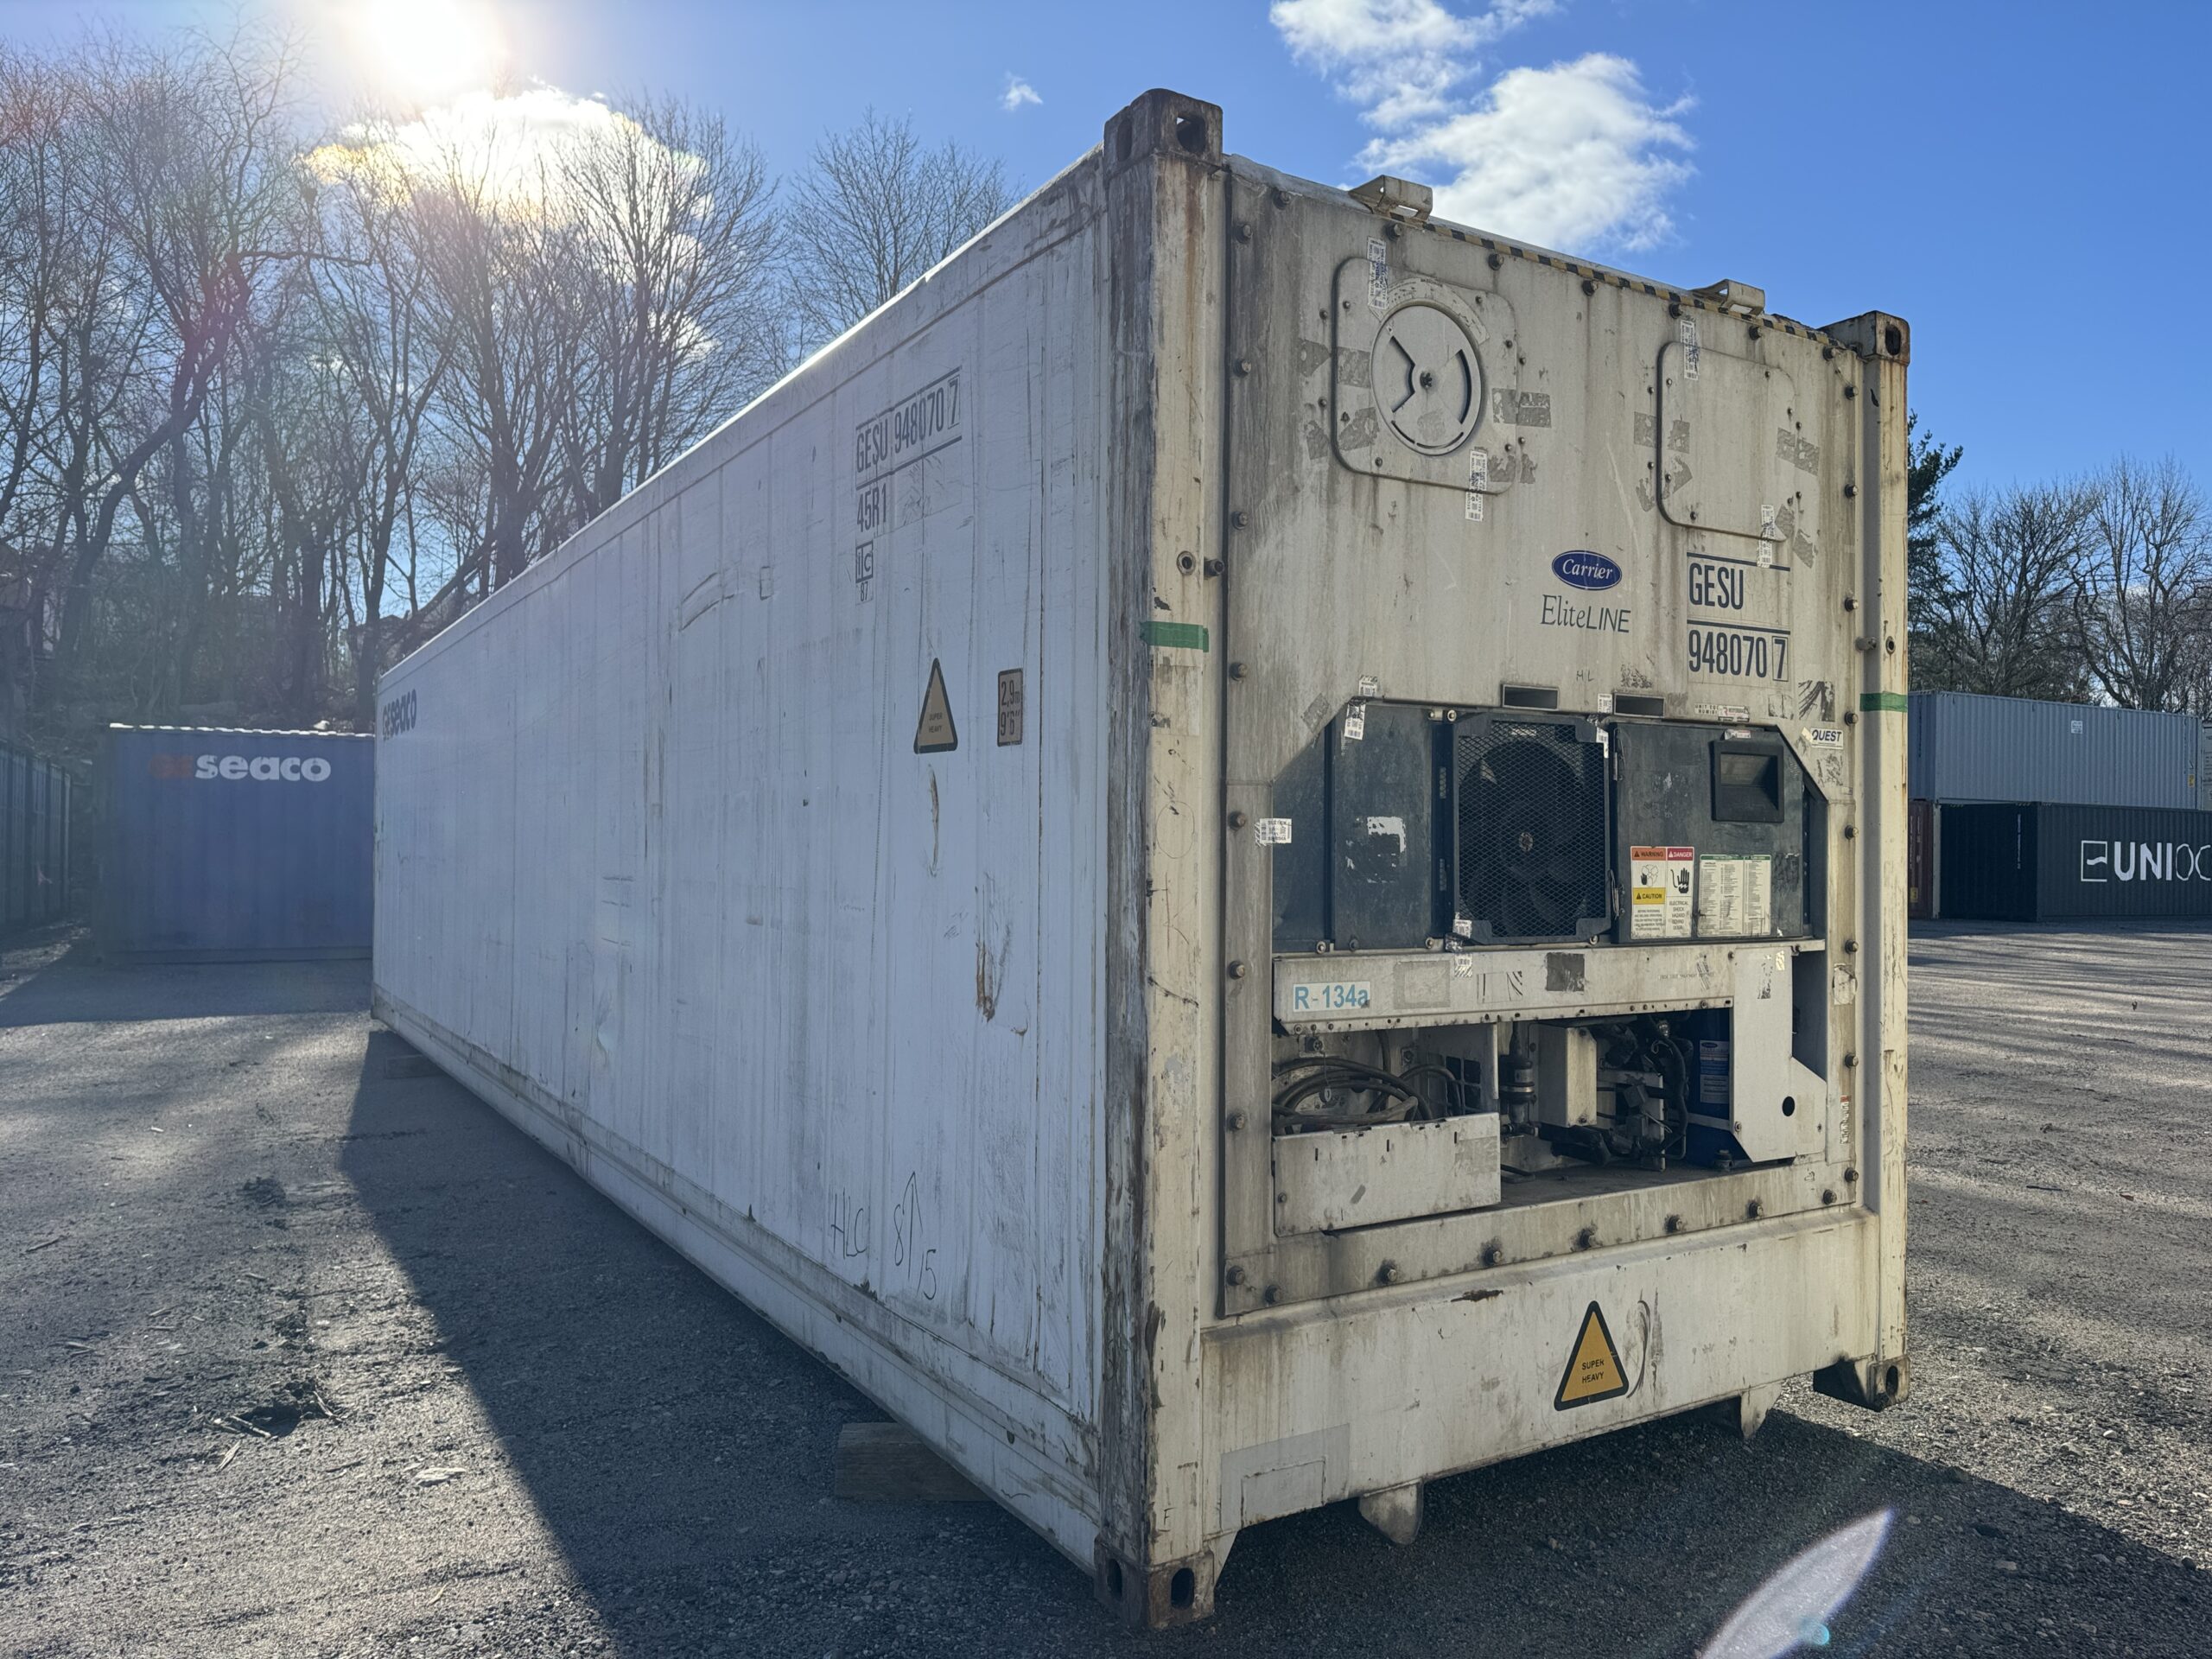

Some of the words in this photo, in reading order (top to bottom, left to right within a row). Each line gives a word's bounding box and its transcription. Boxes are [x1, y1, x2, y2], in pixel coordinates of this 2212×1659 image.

[856, 418, 888, 473] GESU
[894, 388, 944, 454] 948070
[950, 378, 958, 425] 7
[857, 483, 887, 533] 45R1
[1562, 558, 1613, 580] Carrier
[1689, 563, 1744, 610] GESU
[1541, 594, 1631, 633] EliteLINE
[1688, 629, 1768, 678] 948070
[1774, 638, 1786, 679] 7
[194, 754, 332, 782] seaco
[1294, 983, 1369, 1010] R-134a
[1581, 1358, 1605, 1370] SUPER
[1581, 1371, 1605, 1383] HEAVY
